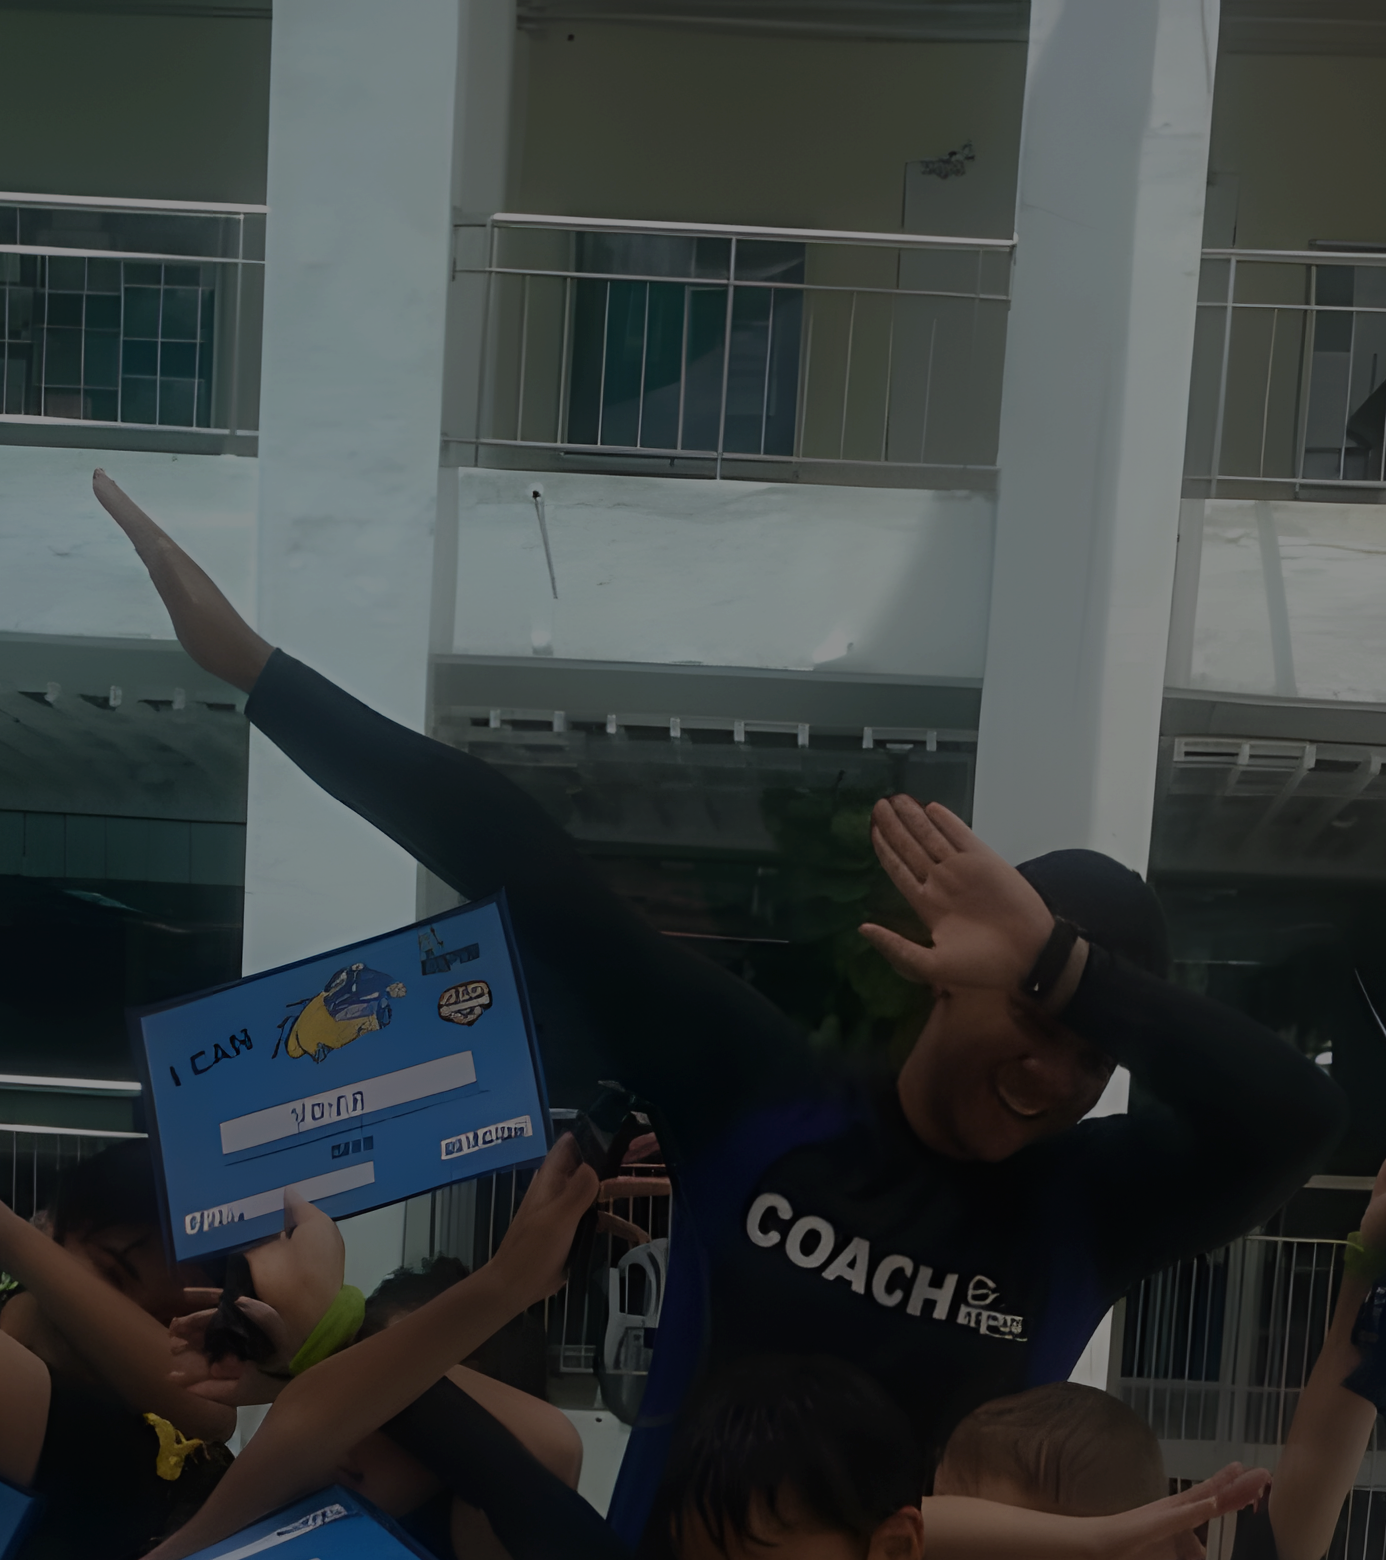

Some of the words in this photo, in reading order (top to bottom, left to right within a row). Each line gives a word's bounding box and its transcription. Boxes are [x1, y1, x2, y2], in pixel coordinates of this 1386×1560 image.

[169, 1065, 182, 1088] I
[190, 1028, 254, 1076] CAN
[745, 1191, 960, 1321] COACH
